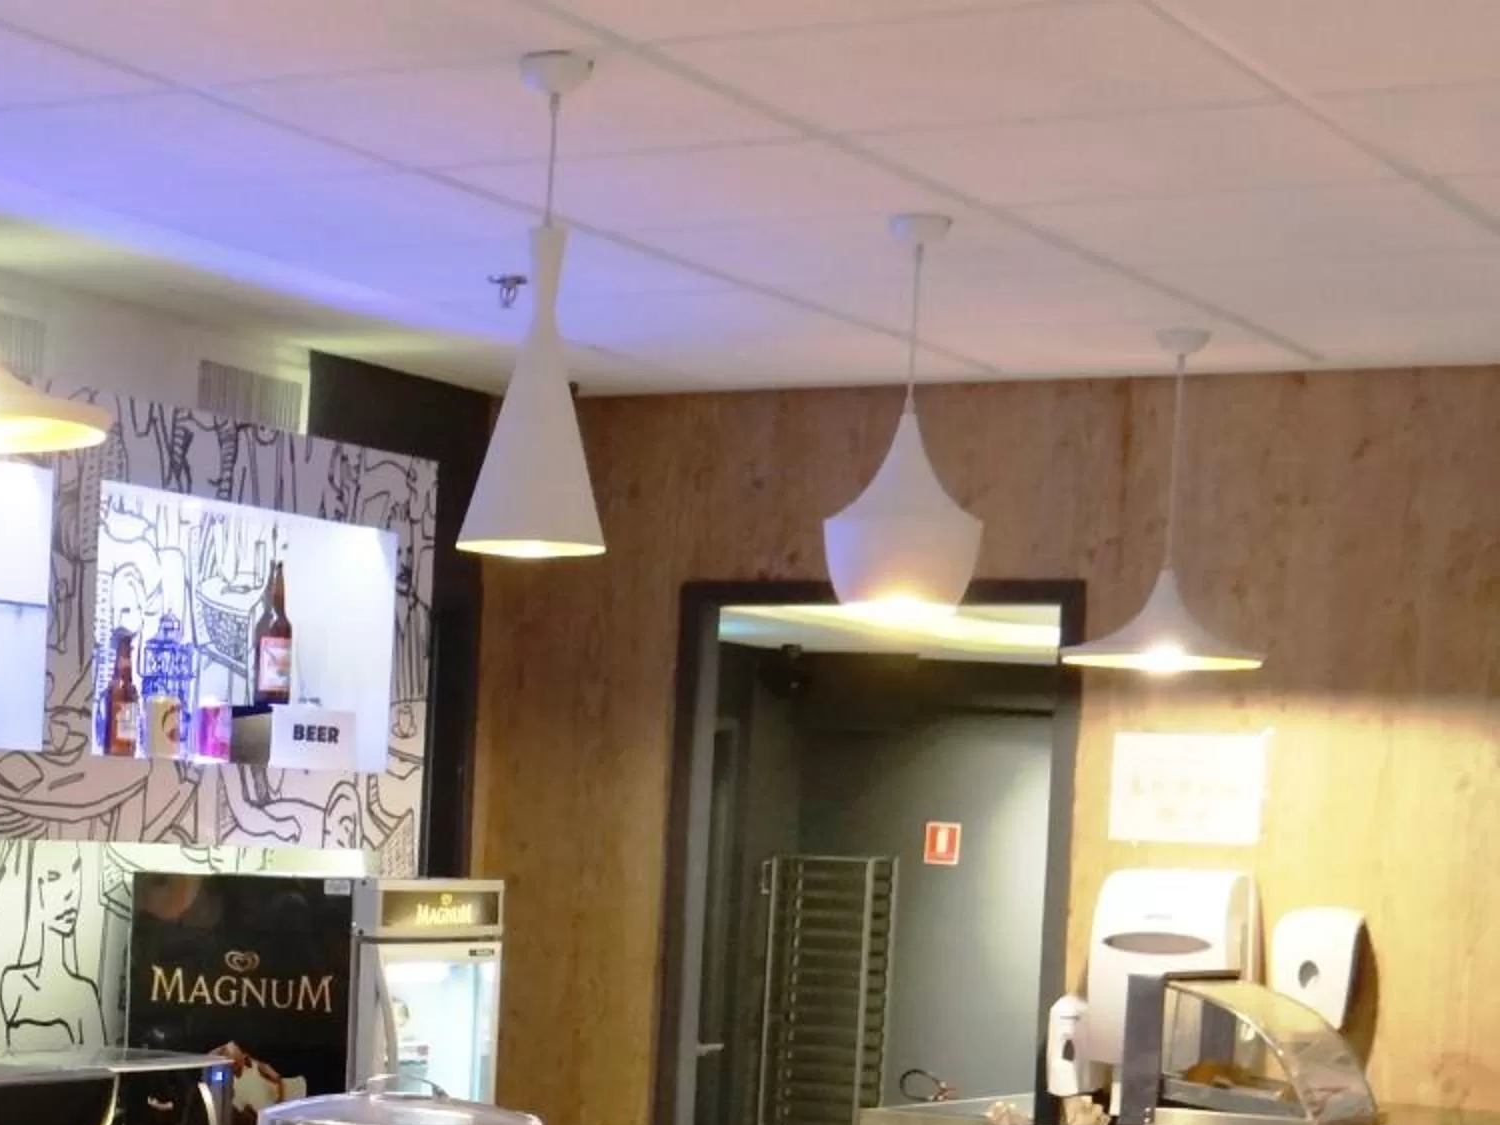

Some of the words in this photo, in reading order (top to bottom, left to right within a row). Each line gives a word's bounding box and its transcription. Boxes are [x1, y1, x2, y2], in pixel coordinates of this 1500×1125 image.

[292, 723, 341, 744] BEER
[415, 902, 473, 926] MAGNUM
[151, 964, 334, 1014] MAGNUM
